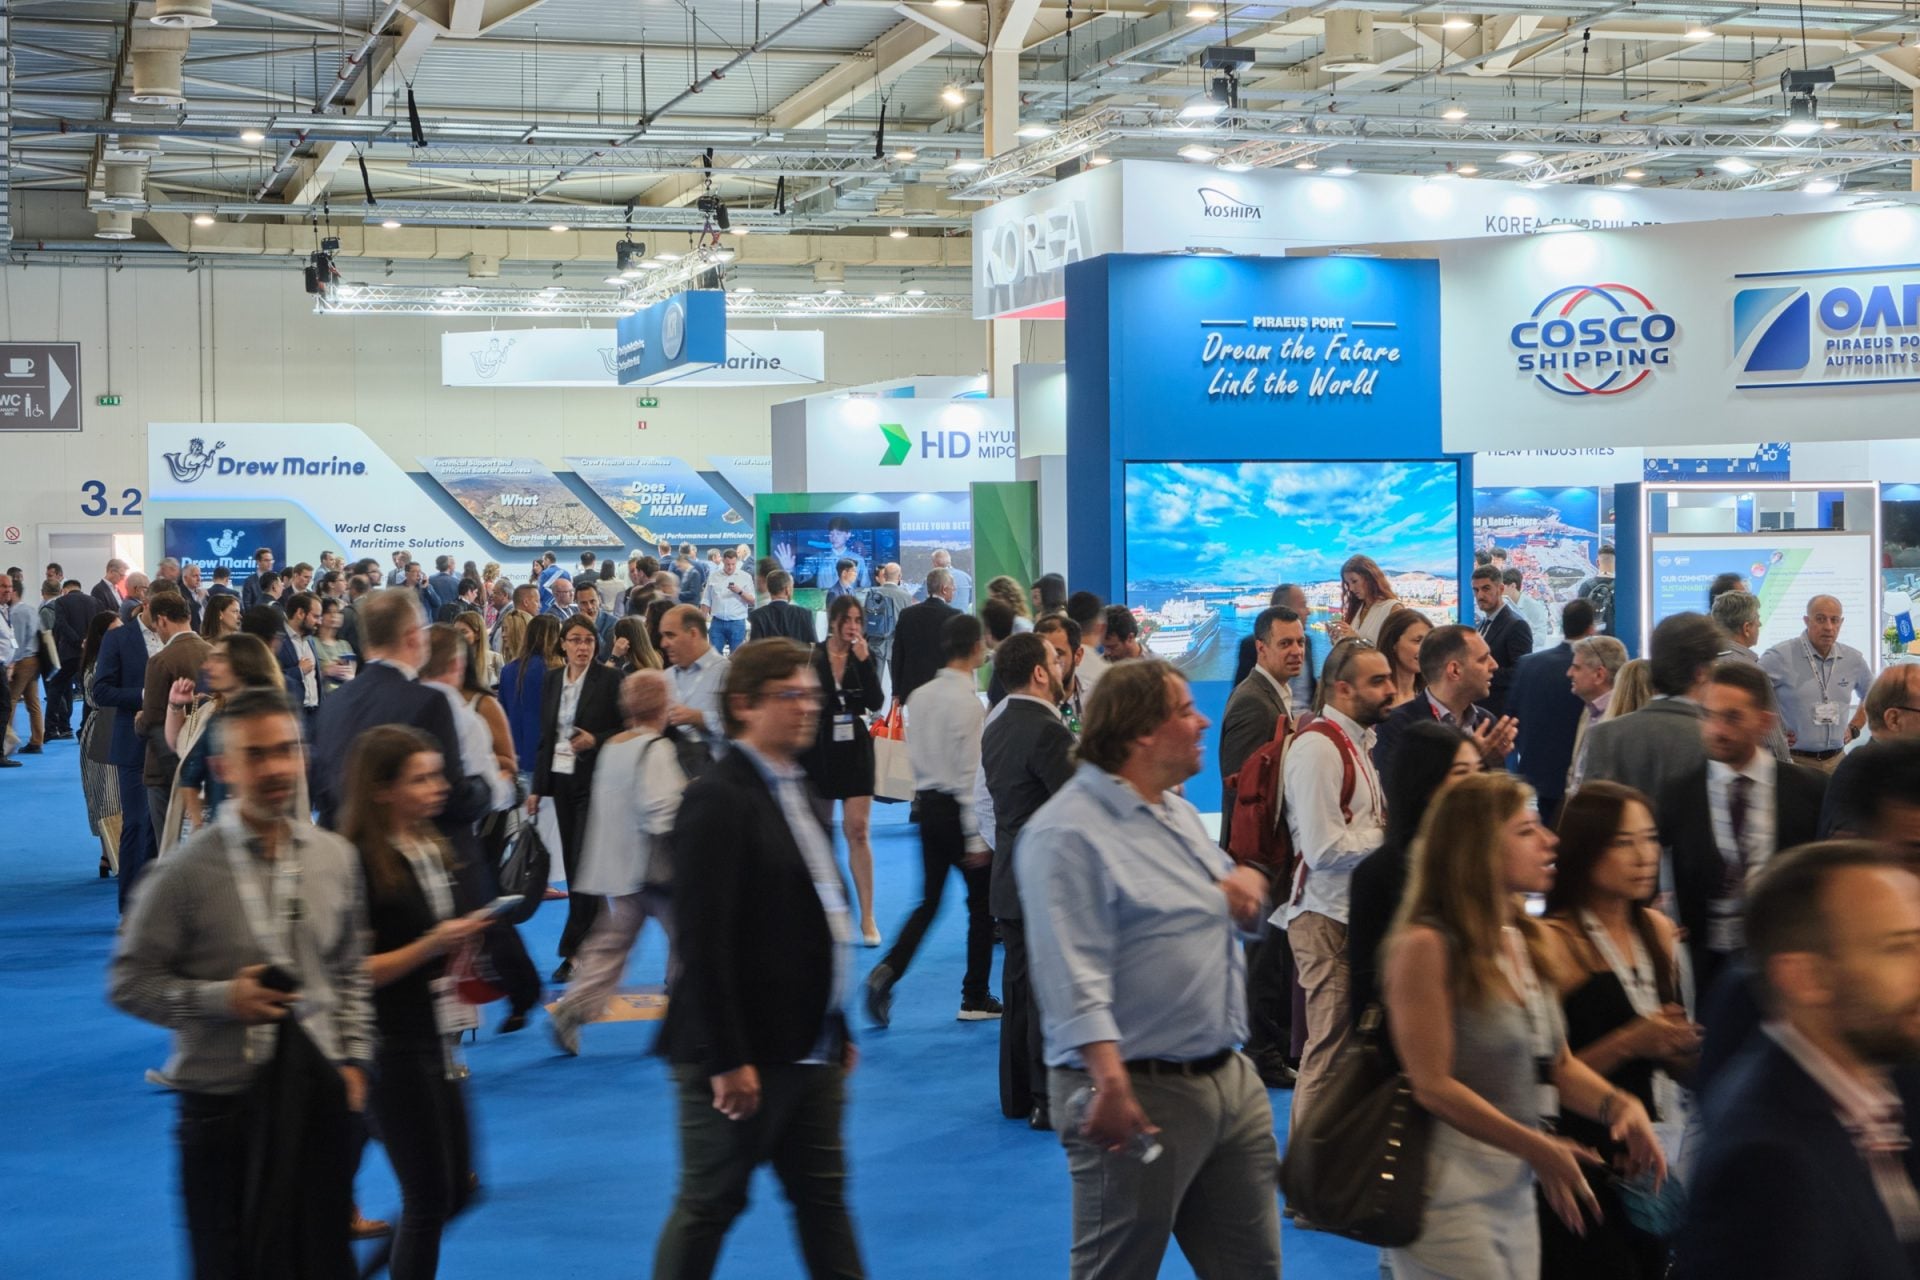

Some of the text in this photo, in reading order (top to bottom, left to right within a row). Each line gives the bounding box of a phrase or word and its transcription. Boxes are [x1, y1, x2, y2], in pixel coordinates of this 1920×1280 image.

[1204, 205, 1261, 219] KOSHIPA
[1485, 215, 1545, 234] KOREA
[982, 200, 1084, 288] KOREA
[1253, 316, 1345, 329] PIRAEUS PORT
[1511, 313, 1675, 349] COSCO
[1202, 332, 1400, 362] Dream the Future
[1826, 336, 1894, 351] PIRAEUS
[713, 352, 781, 370] arine
[1518, 347, 1669, 371] SHIPPING
[1826, 353, 1906, 366] AUTHORITY
[1208, 366, 1379, 397] Link the World
[0, 394, 21, 406] WC
[921, 431, 971, 458] HD
[217, 456, 366, 475] Drew Marine
[632, 481, 665, 493] Does
[80, 480, 142, 517] 3.2
[501, 494, 539, 506] What
[641, 493, 685, 505] DREW
[650, 505, 708, 516] MARINE
[335, 524, 406, 533] World Class
[902, 521, 929, 531] CREATE
[350, 538, 465, 549] Maritime Solutions
[182, 557, 218, 568] Drew
